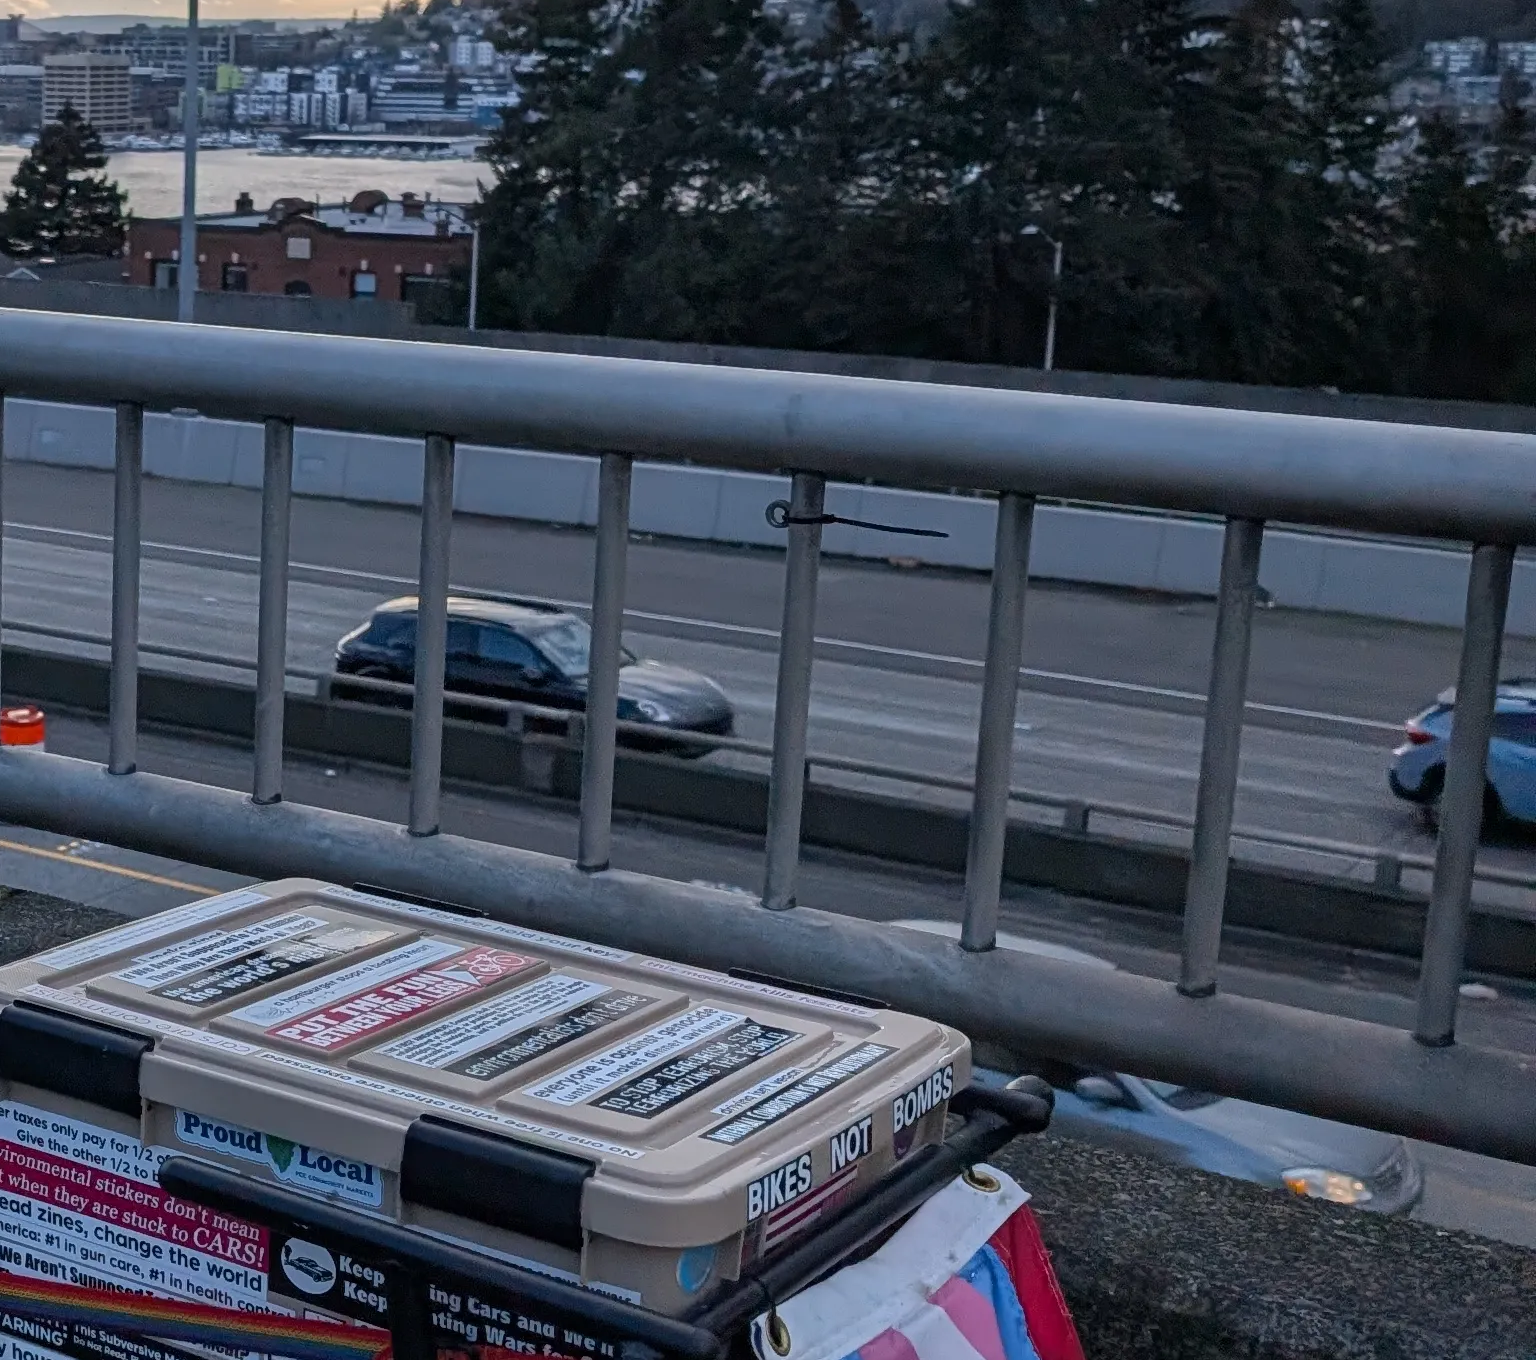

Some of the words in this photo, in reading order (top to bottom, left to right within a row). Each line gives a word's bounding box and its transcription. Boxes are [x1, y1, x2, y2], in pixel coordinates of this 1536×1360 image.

[583, 946, 623, 959] keys
[160, 986, 191, 997] the
[189, 964, 249, 987] american
[179, 986, 224, 1002] the
[214, 960, 289, 988] world's
[759, 987, 794, 998] kills
[799, 996, 867, 1015] fascists
[276, 1015, 342, 1038] PUT
[330, 994, 394, 1016] THE
[382, 974, 444, 995] FUN
[303, 1013, 390, 1045] BETWEEN
[375, 995, 432, 1015] YOUR
[417, 980, 469, 998] LEGS
[154, 1022, 195, 1037] are
[198, 1034, 251, 1053] cars
[463, 1022, 583, 1075] environmentalists
[598, 992, 647, 1011] drive
[605, 1058, 647, 1077] makes
[643, 1039, 683, 1058] dinner
[680, 1014, 736, 1040] awkward)
[260, 1052, 353, 1080] oppressed
[533, 1065, 602, 1097] everyone
[592, 1057, 616, 1066] is
[607, 1034, 662, 1059] against
[655, 1007, 717, 1035] genocide
[599, 1097, 632, 1109] TO
[619, 1078, 666, 1098] STOP
[727, 1025, 767, 1043] STOP
[354, 1079, 386, 1090] are
[387, 1088, 446, 1106] others
[626, 1067, 719, 1113] TERRORIZING
[711, 1053, 747, 1068] THE
[183, 1112, 262, 1154] Proud
[446, 1104, 499, 1122] when
[502, 1119, 543, 1133] free
[14, 1109, 48, 1130] taxes
[51, 1121, 78, 1140] only
[82, 1133, 106, 1150] pay
[110, 1137, 129, 1154] for
[132, 1144, 153, 1161] 1/2
[17, 1129, 44, 1147] Give
[48, 1137, 69, 1155] the
[72, 1147, 107, 1166] other
[110, 1157, 130, 1174] 1/2
[134, 1168, 148, 1179] to
[567, 1135, 603, 1148] one
[607, 1145, 637, 1157] No
[748, 1154, 811, 1220] BIKES
[831, 1119, 871, 1173] NOT
[893, 1066, 953, 1132] BOMBS
[299, 1144, 374, 1185] Local
[8, 1173, 49, 1198] when
[54, 1186, 89, 1213] they
[92, 1201, 119, 1219] are
[121, 1210, 167, 1237] stuck
[172, 1224, 189, 1242] to
[193, 1226, 265, 1268] CARS!
[95, 1177, 160, 1208] stickers
[164, 1196, 209, 1225] don't
[212, 1213, 260, 1242] mean
[25, 1252, 67, 1281] Aren't
[37, 1206, 89, 1238] zines,
[94, 1224, 163, 1258] change
[169, 1246, 201, 1271] the
[206, 1261, 262, 1292] world
[45, 1232, 60, 1249] #1
[64, 1239, 76, 1255] in
[81, 1247, 106, 1265] gun
[109, 1257, 145, 1279] care,
[149, 1267, 165, 1284] #1
[169, 1273, 182, 1290] in
[186, 1279, 233, 1308] health
[339, 1254, 385, 1288] Keep
[468, 1297, 511, 1325] Cars
[517, 1315, 555, 1339] and
[344, 1280, 388, 1313] Keep
[99, 1330, 162, 1360] Subversive
